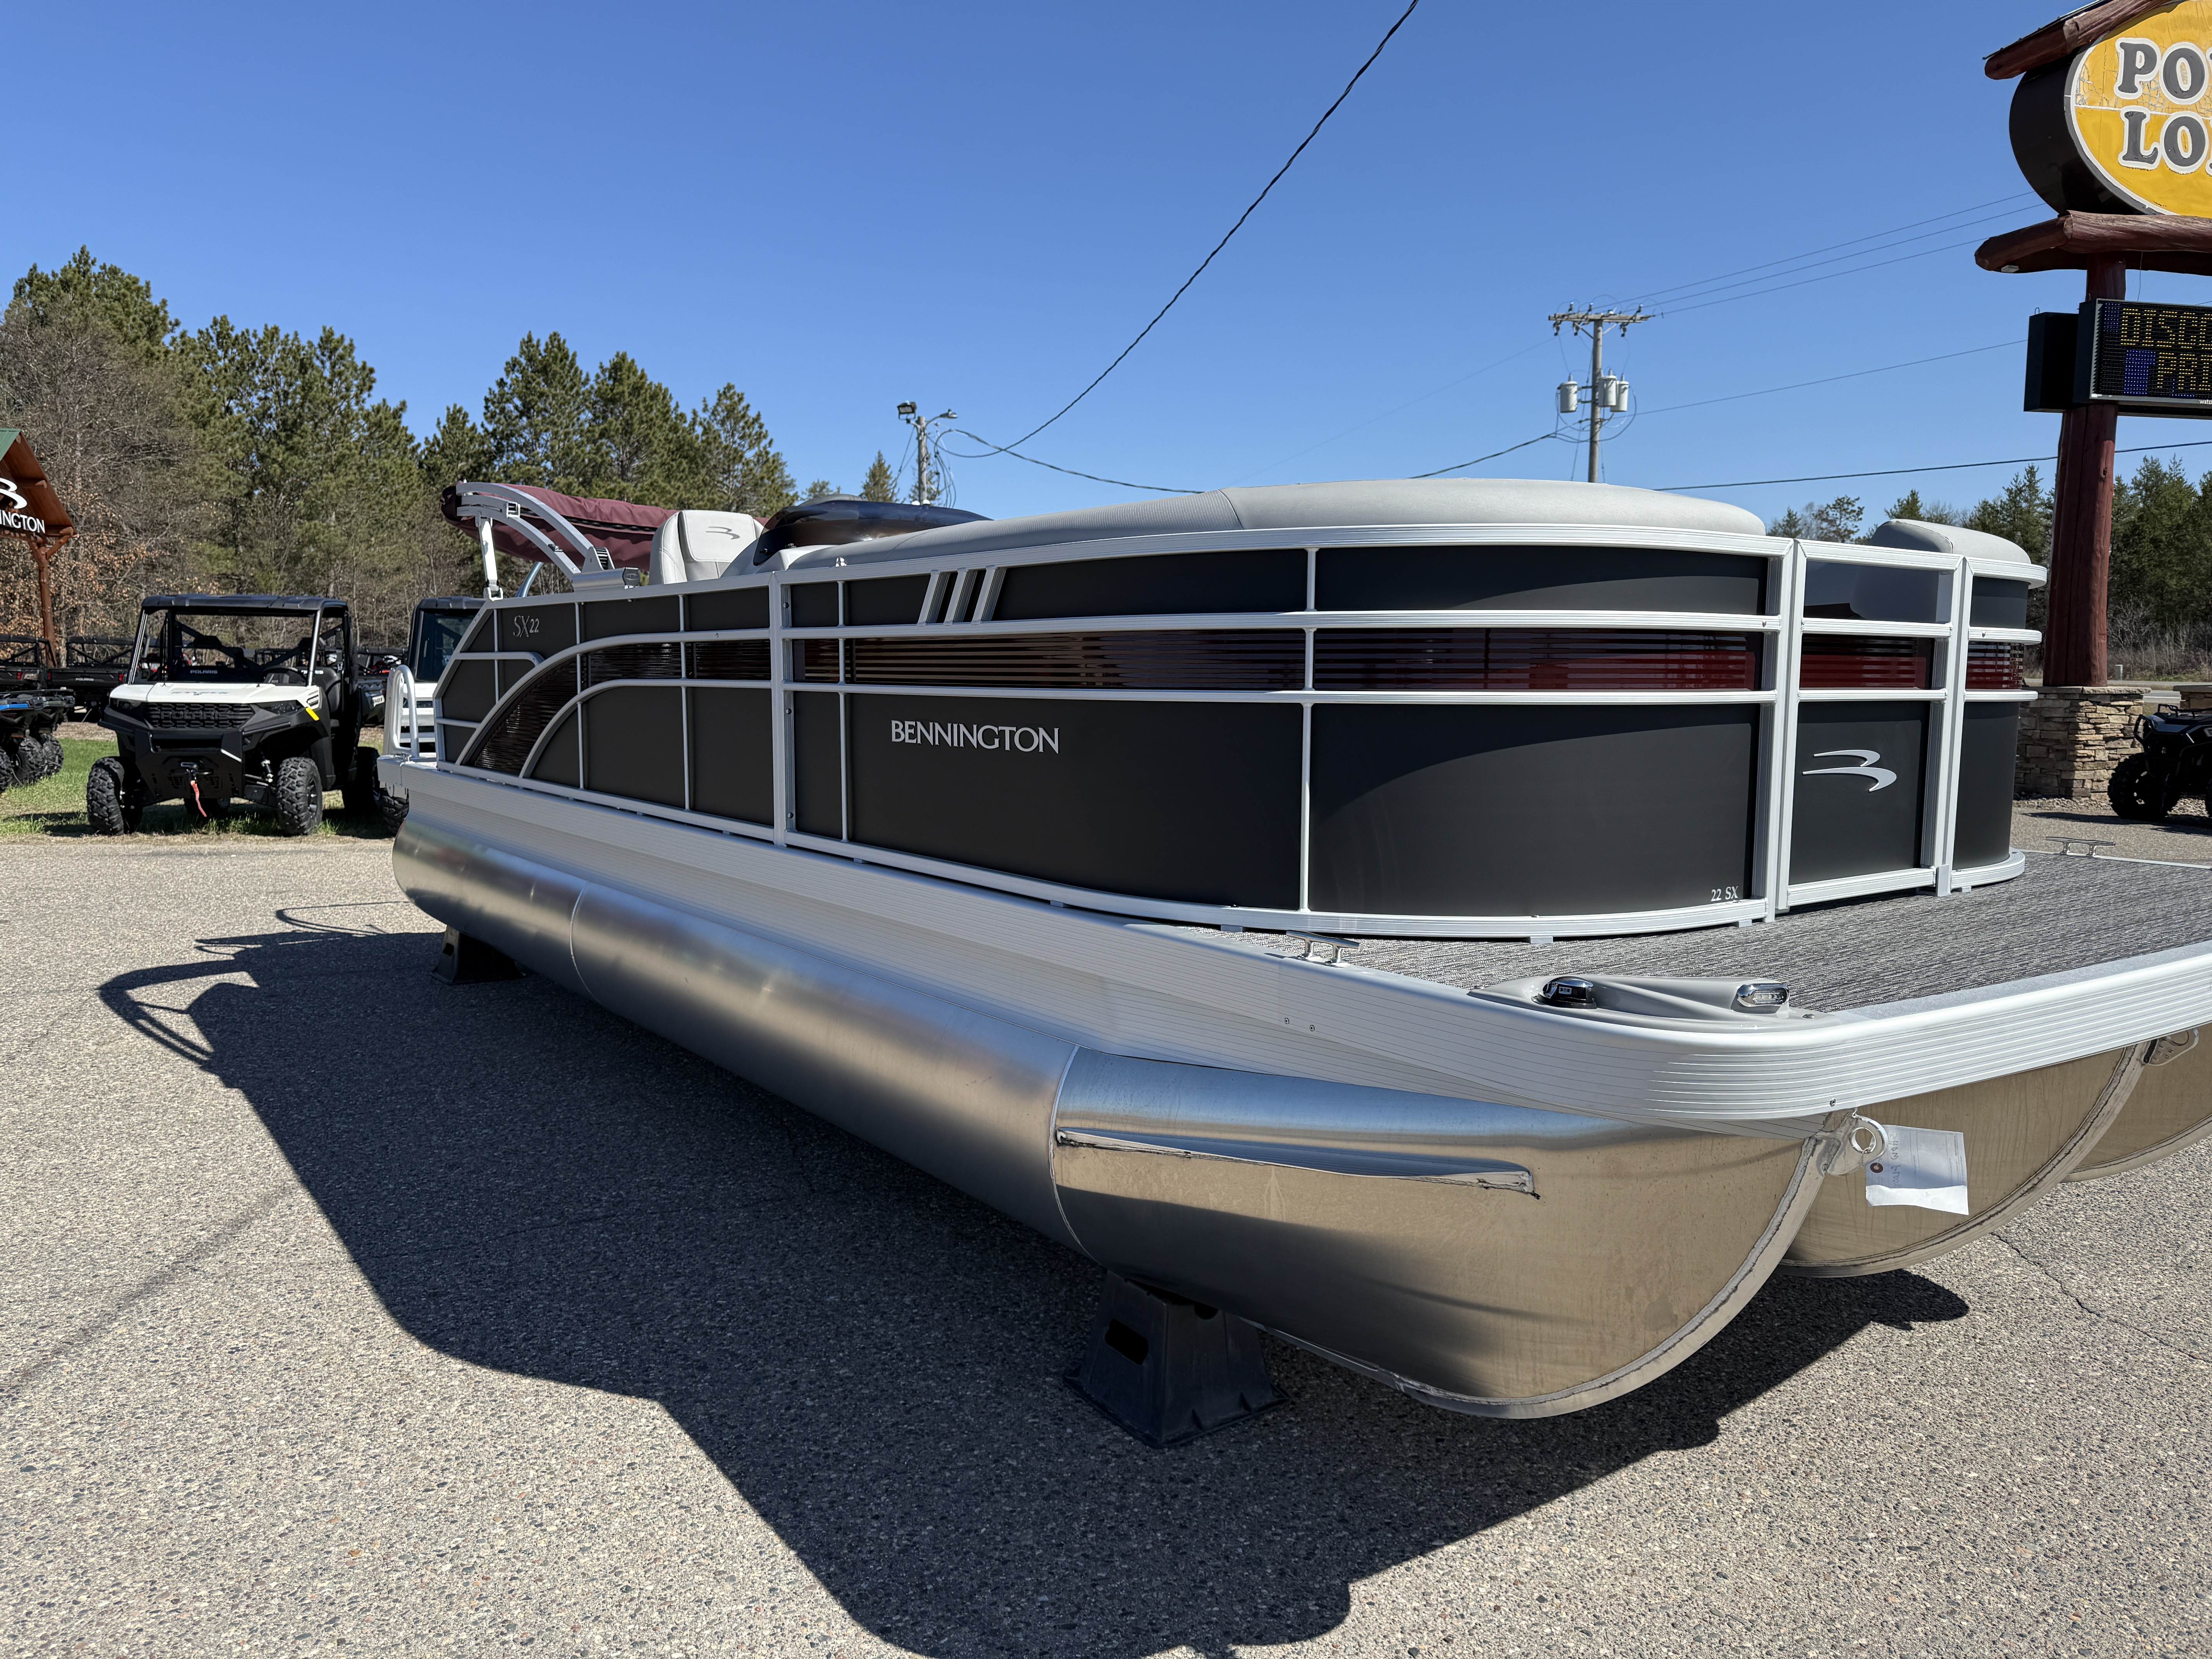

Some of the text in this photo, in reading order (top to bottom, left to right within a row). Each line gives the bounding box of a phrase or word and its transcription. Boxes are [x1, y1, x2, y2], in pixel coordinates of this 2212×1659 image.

[2116, 38, 2212, 105] PO
[2119, 106, 2212, 175] LO
[161, 710, 229, 720] POLARIS
[891, 720, 1060, 754] BENNINGTON
[1711, 886, 1739, 902] 22 SX
